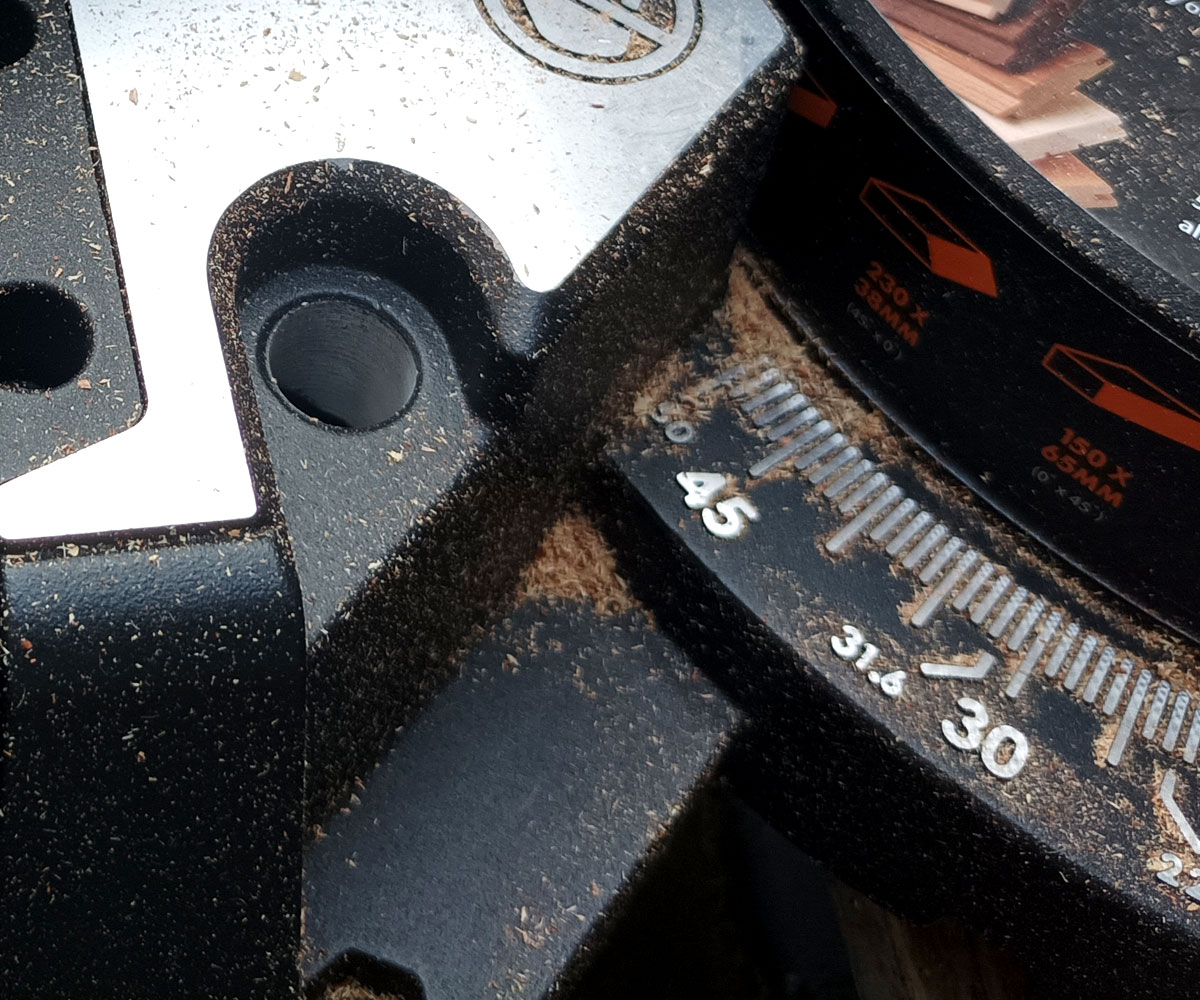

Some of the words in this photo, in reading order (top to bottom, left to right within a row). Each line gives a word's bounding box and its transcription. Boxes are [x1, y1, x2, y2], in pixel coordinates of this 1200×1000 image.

[1041, 444, 1124, 508] 65MM
[1060, 427, 1107, 468] 150
[676, 471, 760, 539] 45
[941, 699, 1029, 779] 30
